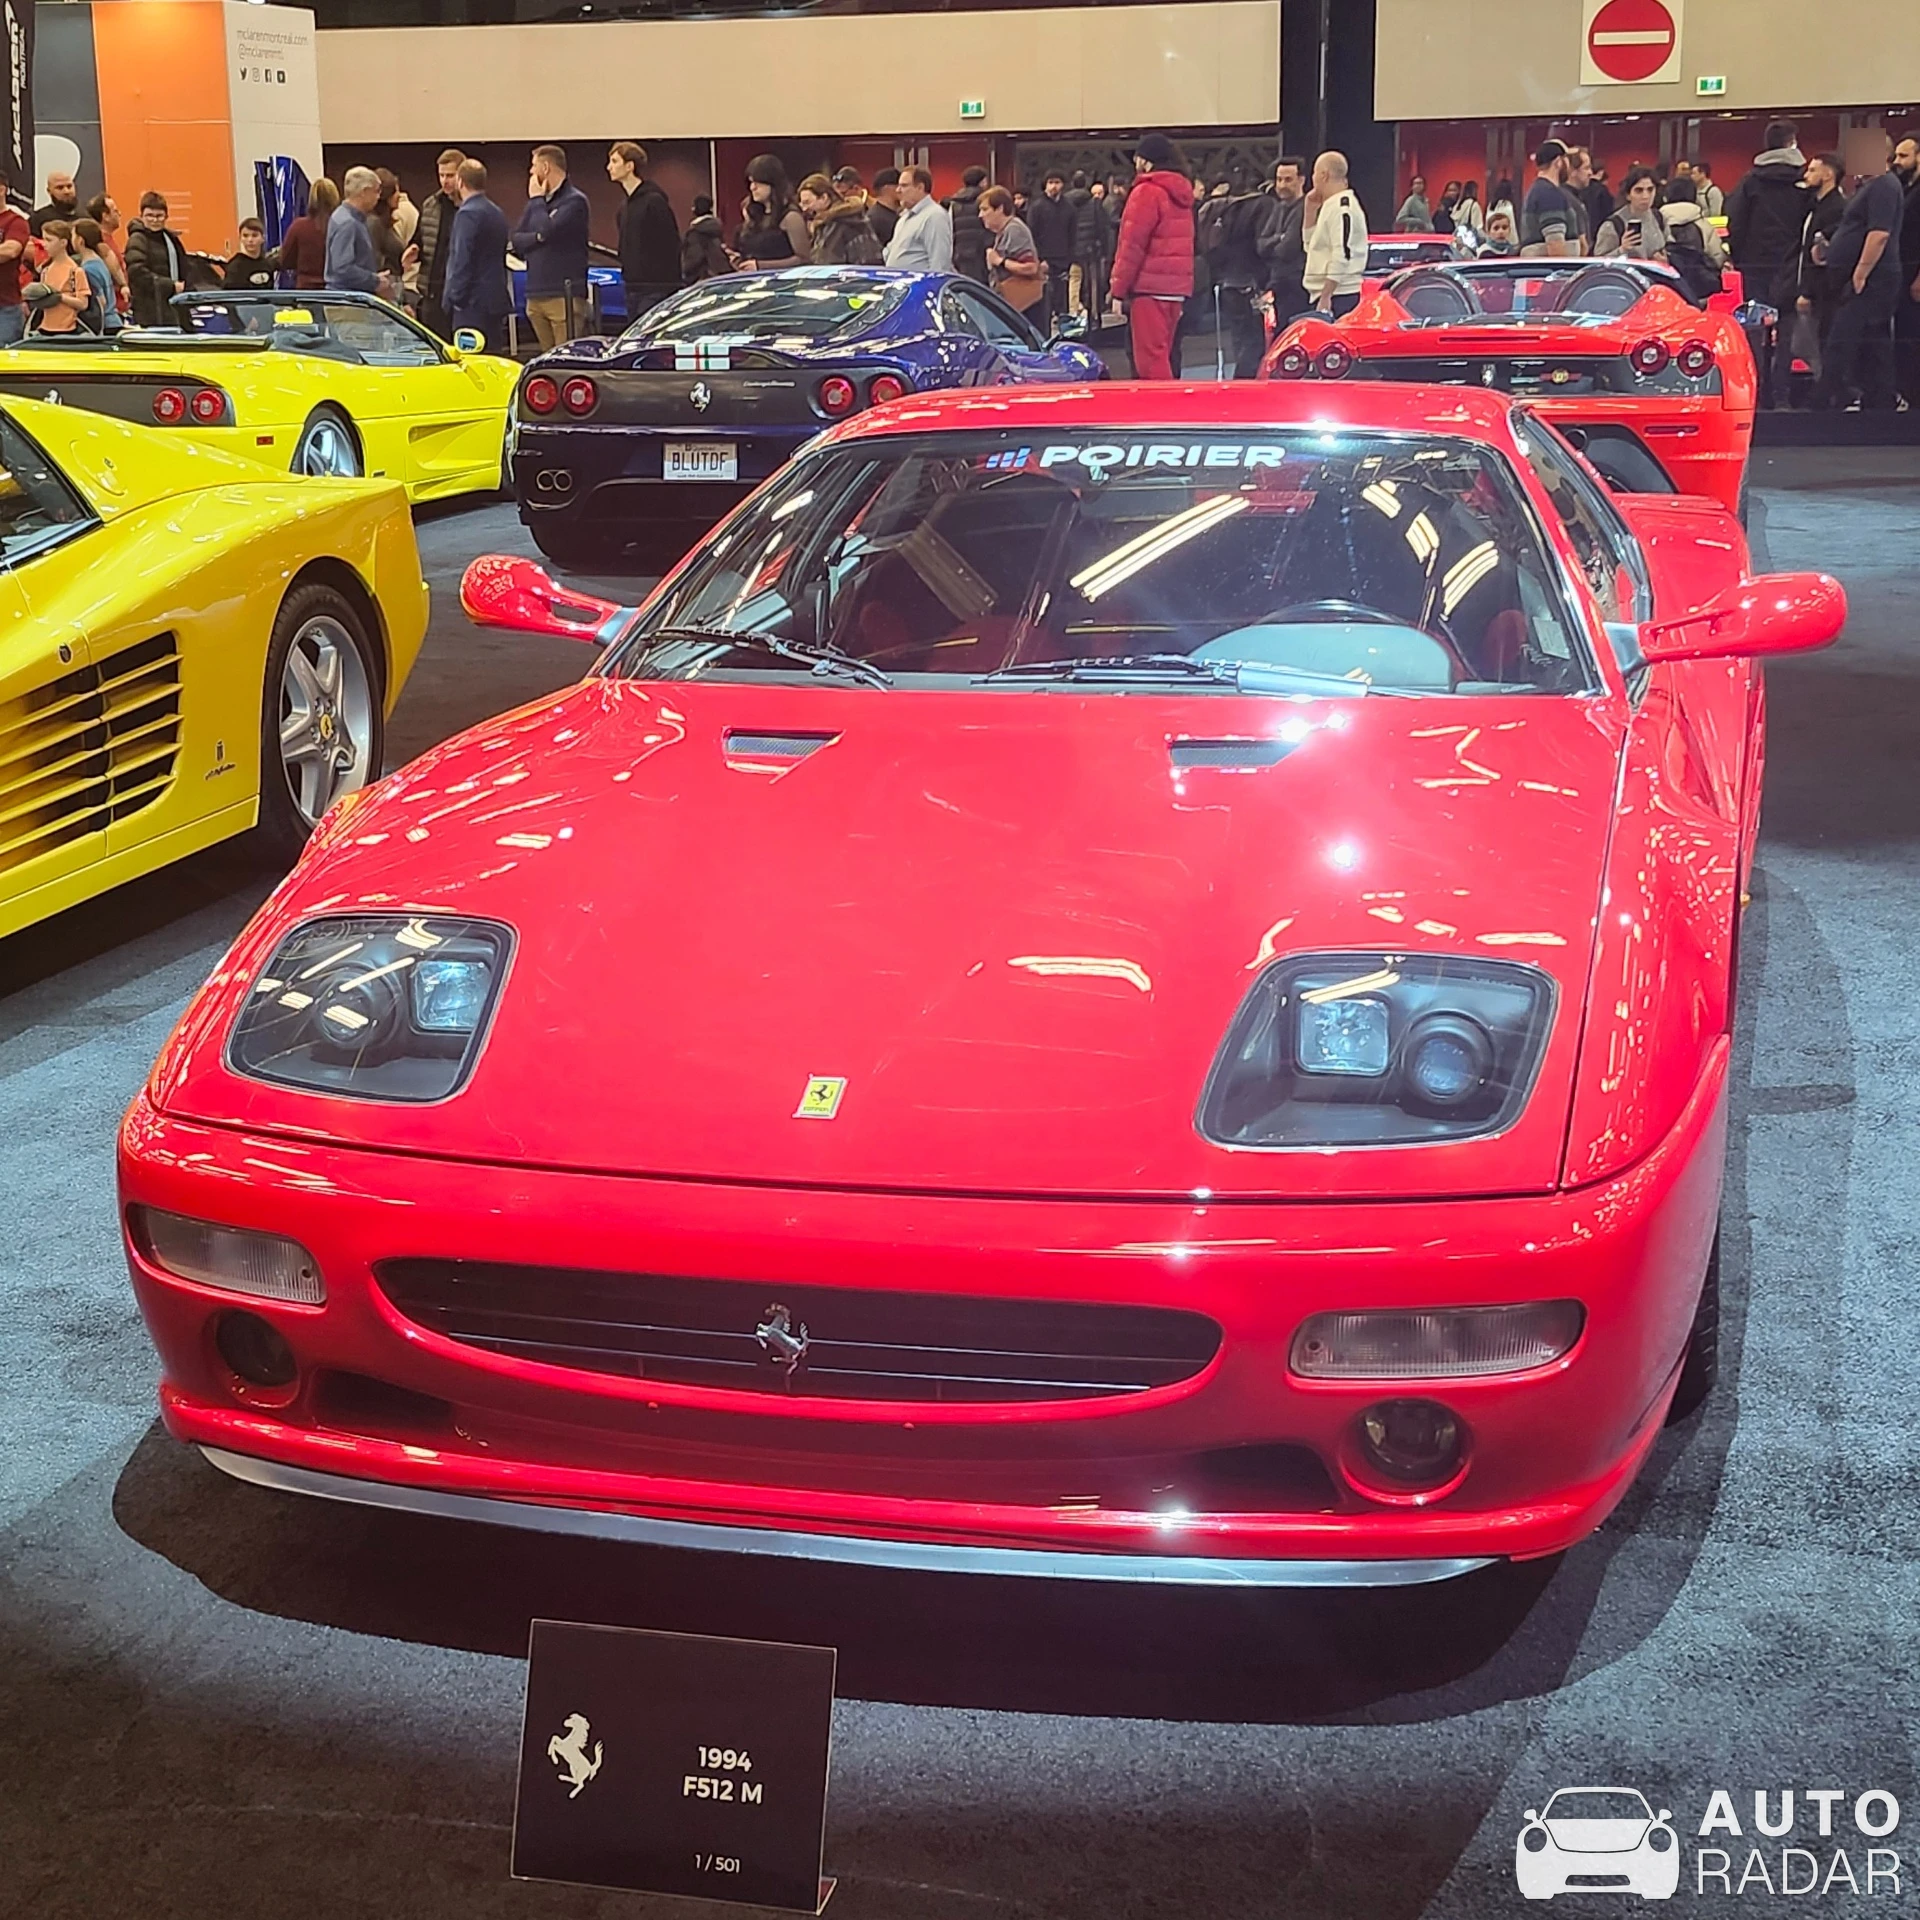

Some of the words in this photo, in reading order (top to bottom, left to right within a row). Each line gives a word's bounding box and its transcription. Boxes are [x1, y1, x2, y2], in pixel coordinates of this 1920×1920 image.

[671, 451, 729, 471] BLUTDF
[1039, 445, 1286, 467] POIRIER
[698, 1746, 752, 1772] 1994
[683, 1775, 734, 1801] F512
[741, 1781, 763, 1805] M
[715, 1856, 740, 1873] 501
